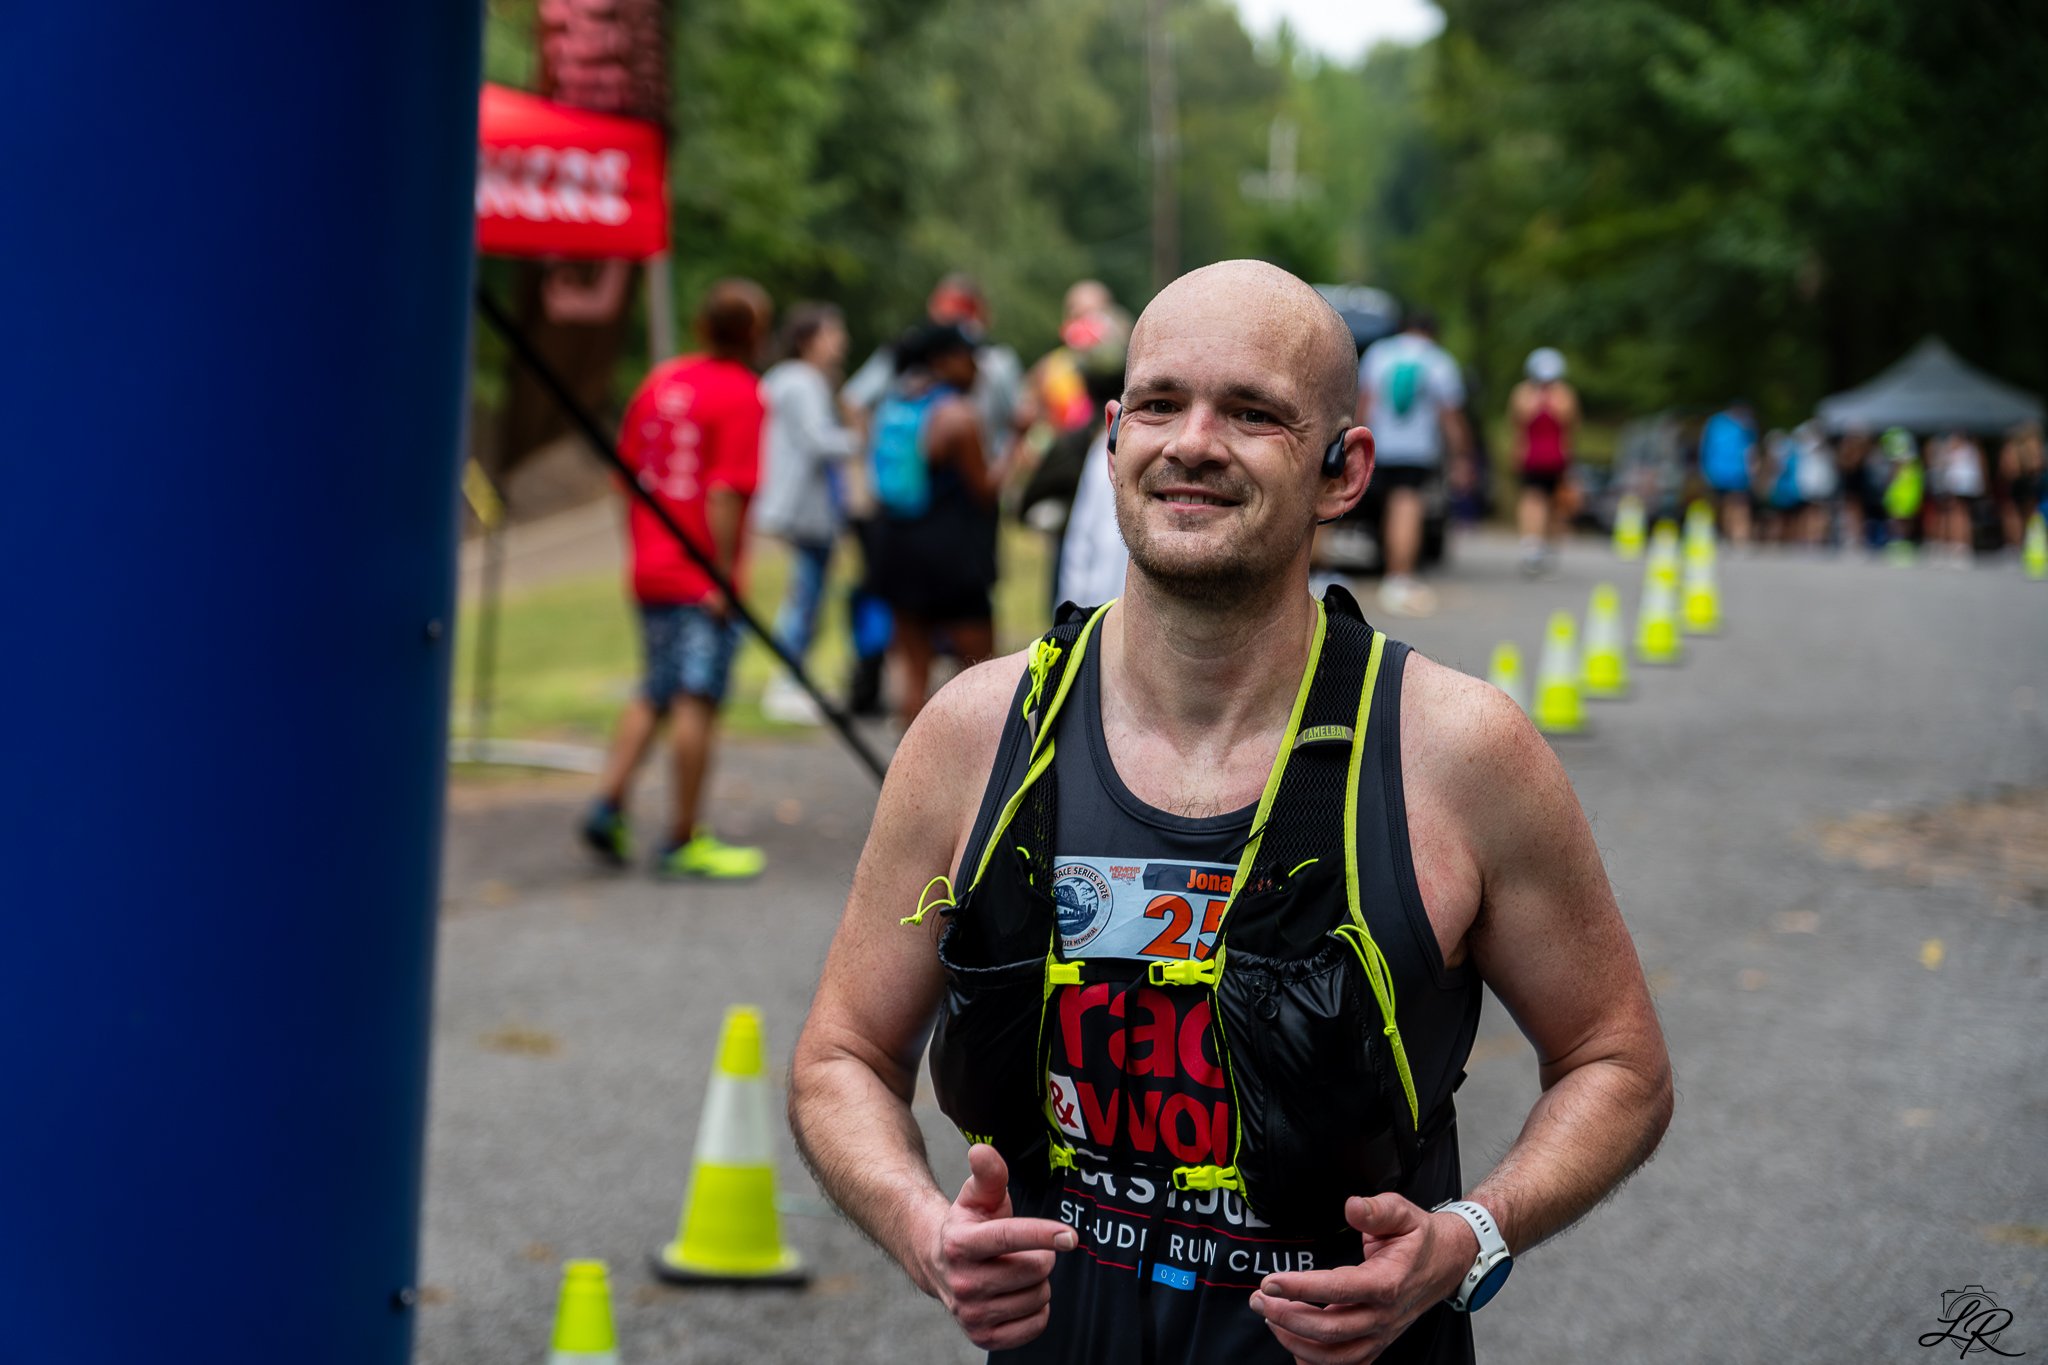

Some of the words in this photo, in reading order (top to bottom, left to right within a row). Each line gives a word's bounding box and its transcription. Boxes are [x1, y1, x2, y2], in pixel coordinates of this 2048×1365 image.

[1303, 726, 1348, 742] CAMELBAK
[1073, 866, 1099, 882] SERIES
[1096, 880, 1110, 899] 2026
[1186, 868, 1233, 893] Jona
[1073, 927, 1098, 946] MEMORIAL
[1169, 1234, 1217, 1266] RUN
[1228, 1249, 1314, 1275] CLUB
[1160, 1269, 1189, 1286] 025
